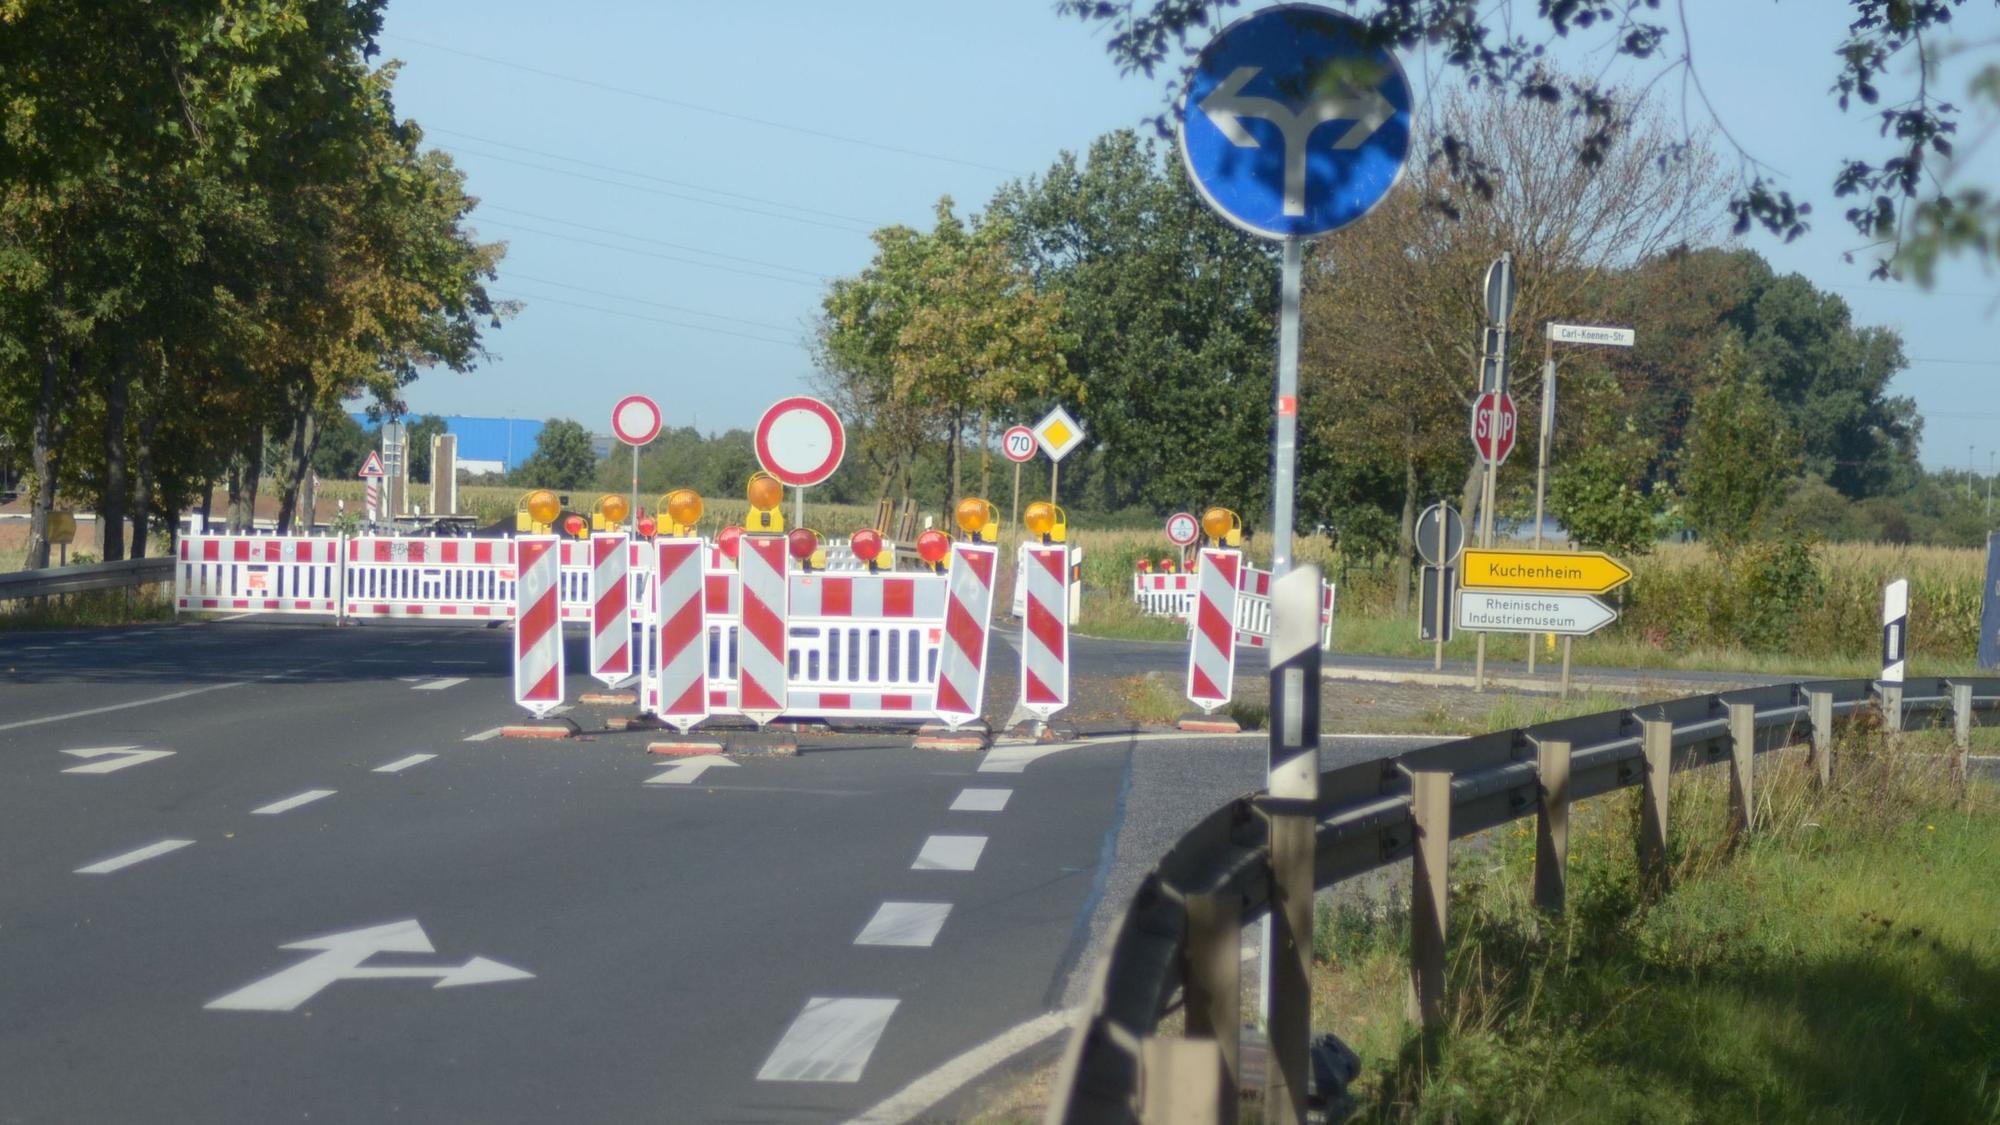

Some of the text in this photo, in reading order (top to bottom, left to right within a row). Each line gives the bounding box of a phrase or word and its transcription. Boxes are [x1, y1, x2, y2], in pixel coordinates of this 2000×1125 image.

[1561, 328, 1626, 342] Carl-Koenen-Str.
[1011, 436, 1030, 452] 70
[1489, 563, 1582, 580] Kuchenheim
[1486, 598, 1560, 612] Rheinisches
[1468, 612, 1576, 628] Industriemuseum
